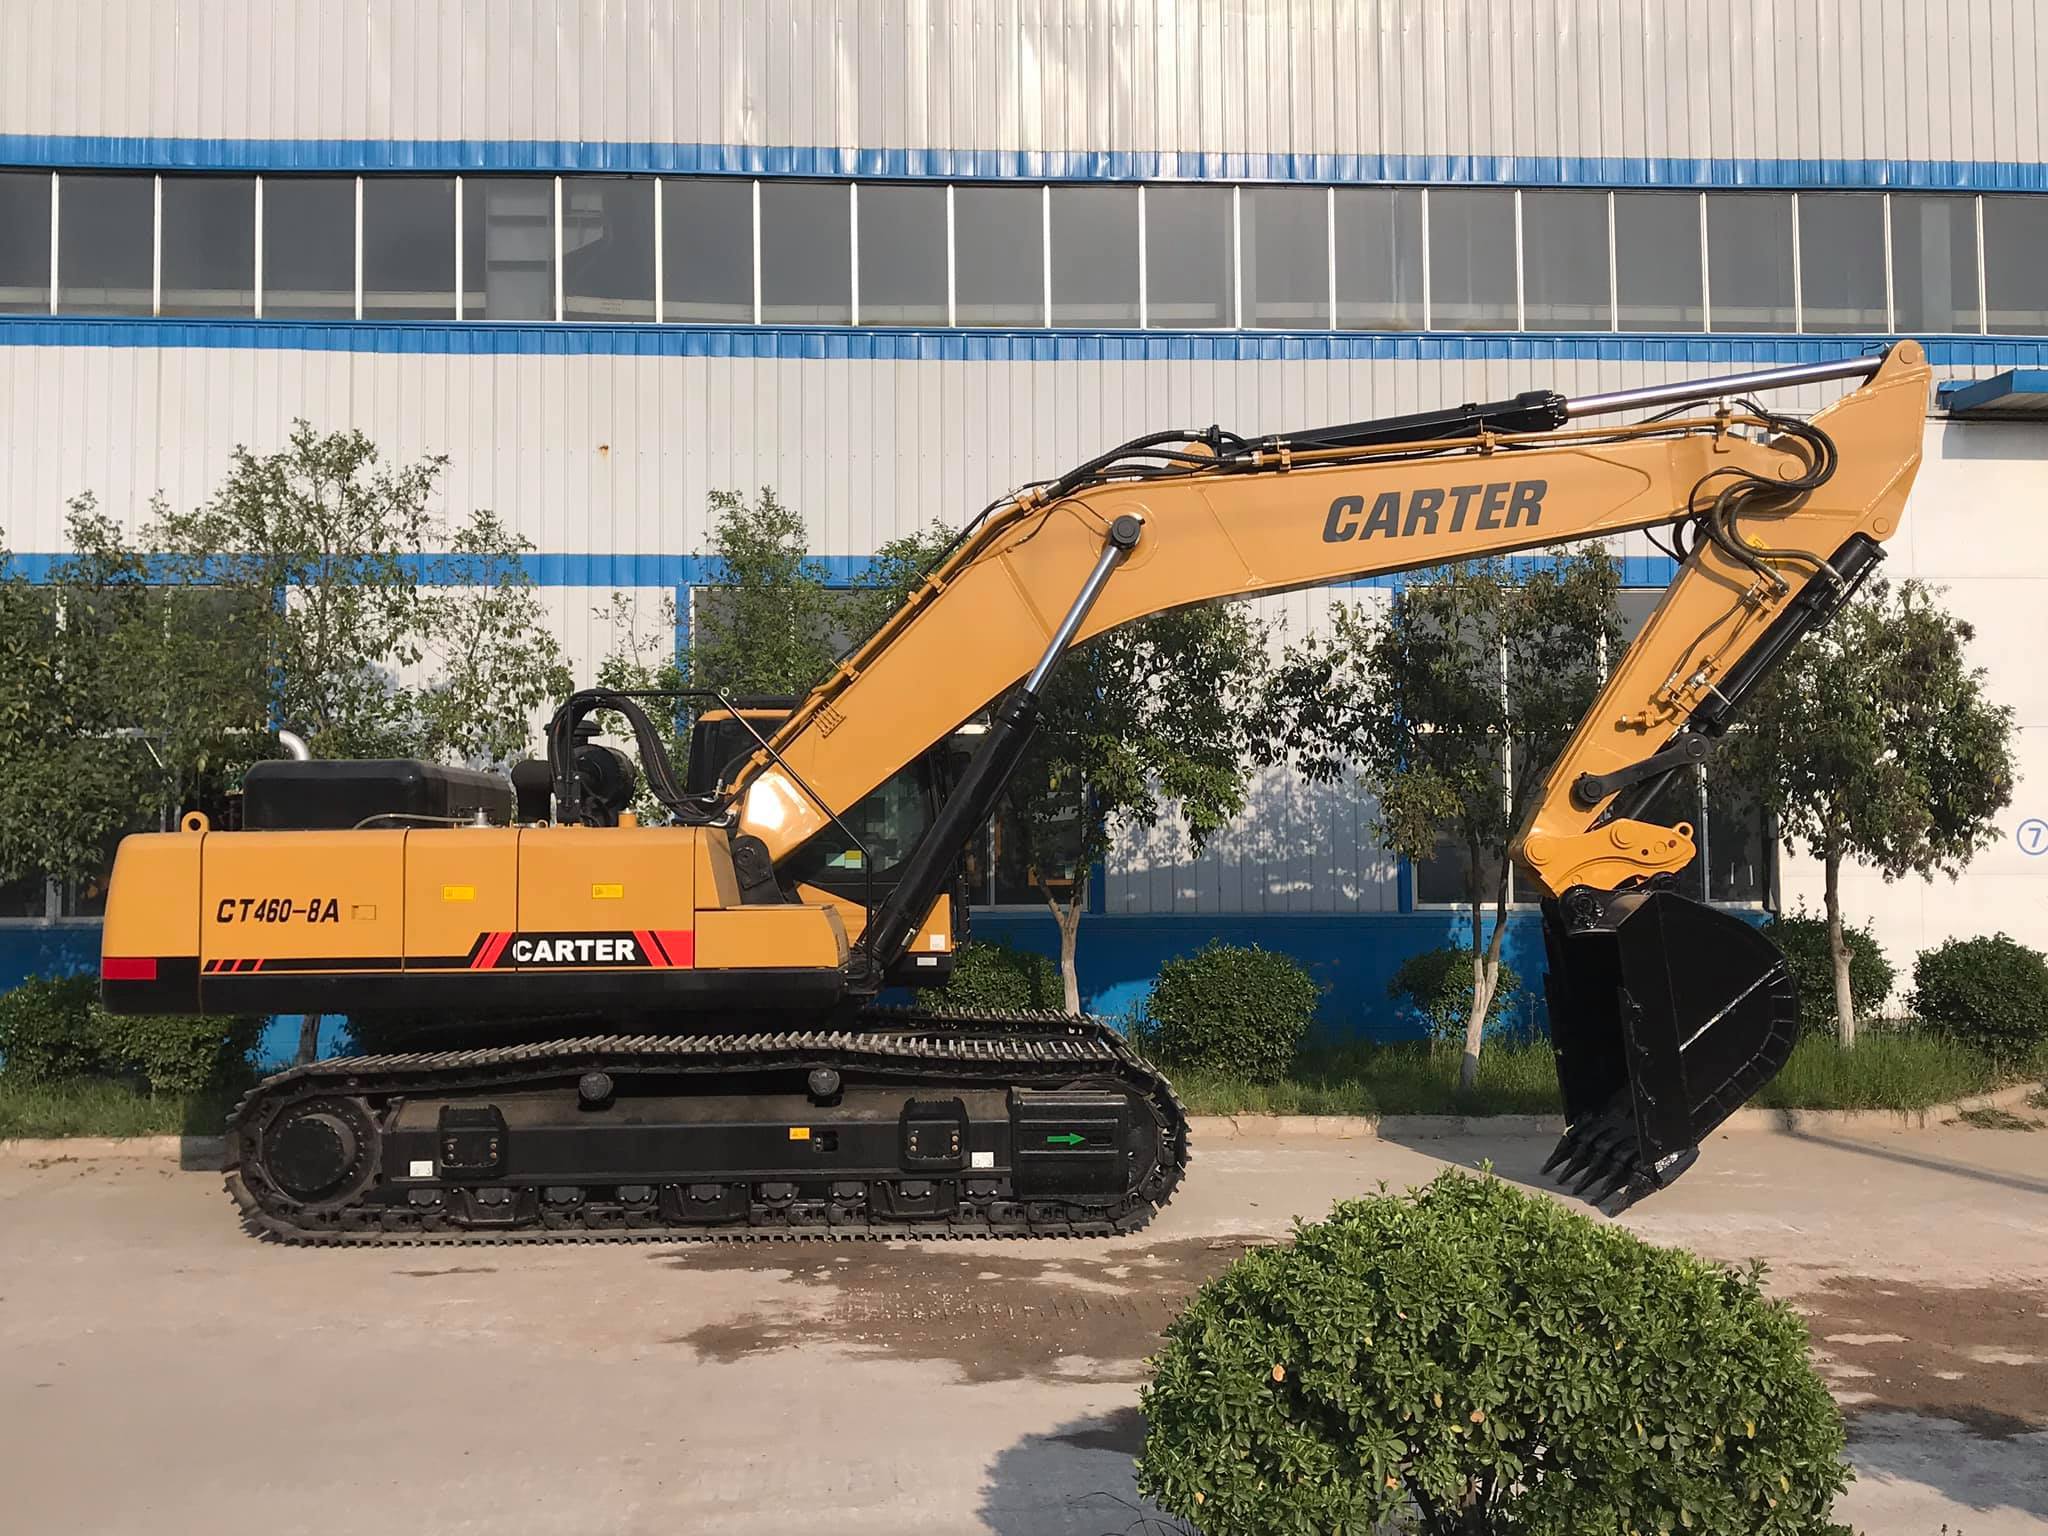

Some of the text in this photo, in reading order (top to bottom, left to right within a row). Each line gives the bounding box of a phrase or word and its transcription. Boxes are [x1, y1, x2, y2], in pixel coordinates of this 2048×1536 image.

[1322, 479, 1548, 543] CARTER
[216, 898, 339, 923] CT460-8A
[512, 939, 636, 962] CARTER
